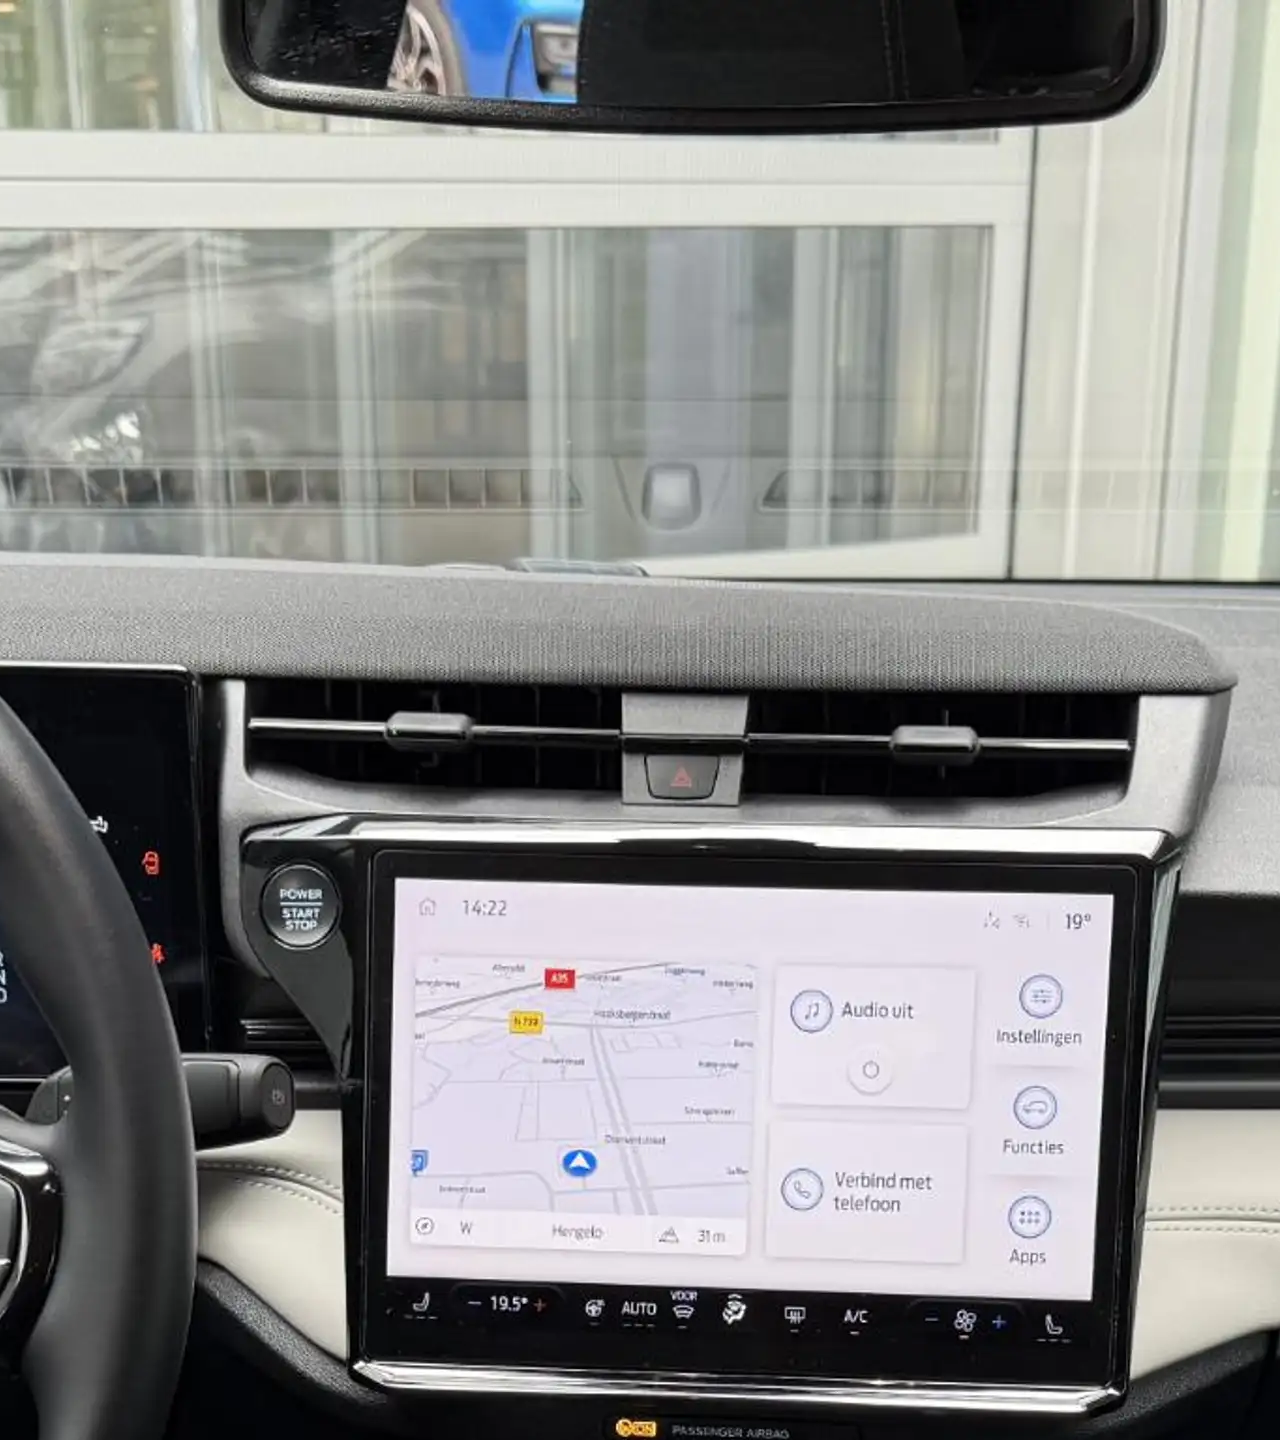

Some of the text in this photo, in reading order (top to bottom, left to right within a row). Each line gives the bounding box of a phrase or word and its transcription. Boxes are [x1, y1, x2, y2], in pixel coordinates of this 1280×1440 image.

[280, 888, 323, 900] POWER
[282, 907, 321, 919] START
[462, 899, 508, 918] 14:22
[284, 919, 318, 931] STOP
[1065, 912, 1092, 930] 19°
[841, 1001, 915, 1019] Audio uit
[995, 1028, 1082, 1048] Instellingen
[1002, 1138, 1065, 1155] Functies
[834, 1171, 932, 1191] Verbind met
[834, 1196, 901, 1213] telefoon
[460, 1221, 472, 1235] W
[551, 1224, 605, 1241] Hengelo
[1009, 1247, 1047, 1266] Apps
[490, 1295, 529, 1312] 19.5°
[670, 1290, 698, 1301] VOOR
[621, 1301, 658, 1316] AUTO
[844, 1309, 869, 1324] A/C
[671, 1424, 790, 1440] PASSENGER AIRBAG
